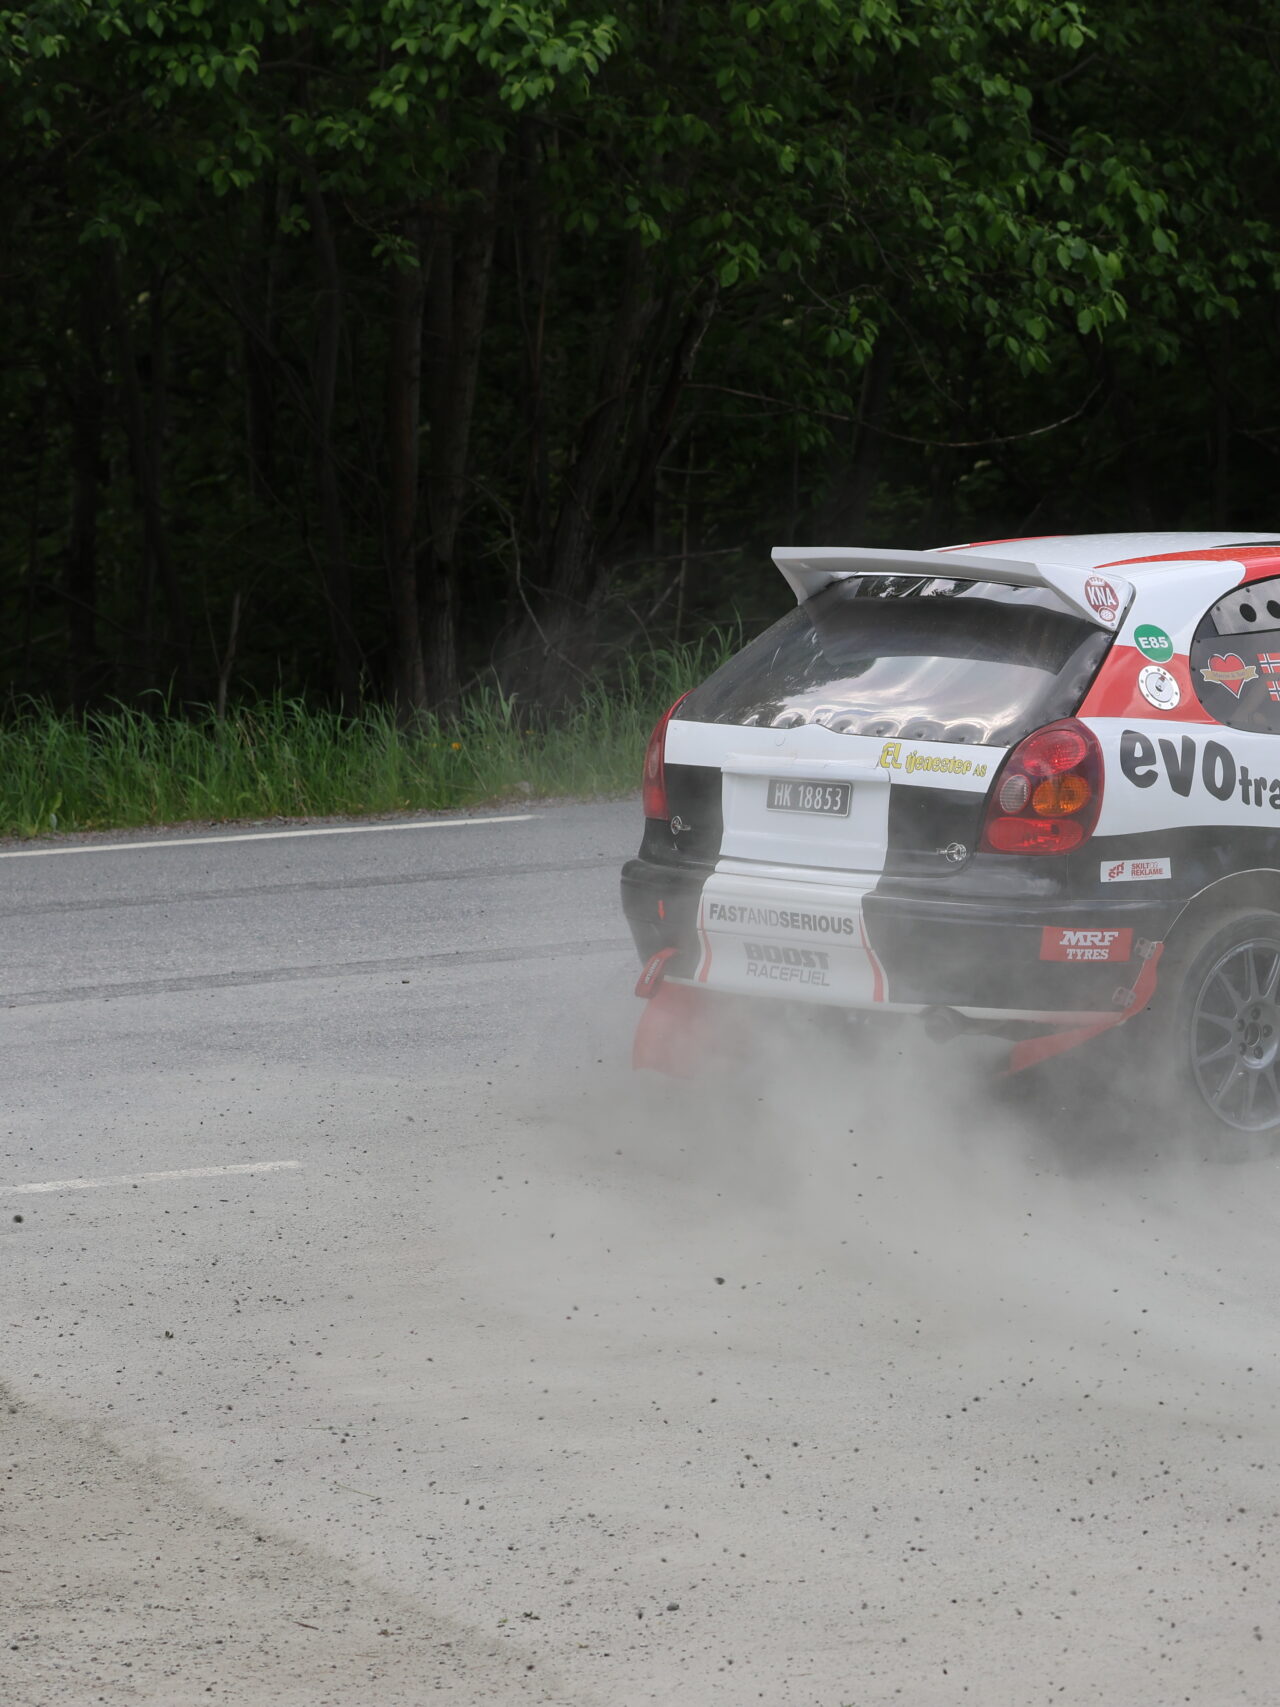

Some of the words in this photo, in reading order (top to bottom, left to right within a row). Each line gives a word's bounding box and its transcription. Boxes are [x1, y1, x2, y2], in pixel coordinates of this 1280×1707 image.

[1087, 585, 1117, 606] KNA
[1138, 636, 1169, 649] E85
[774, 784, 792, 808] HK
[797, 785, 842, 811] 18853
[1131, 867, 1164, 876] REKLAME
[1060, 930, 1119, 946] MRF
[743, 942, 831, 970] BOOST
[1066, 948, 1110, 960] TYRES
[746, 962, 831, 987] RACEFUEL
